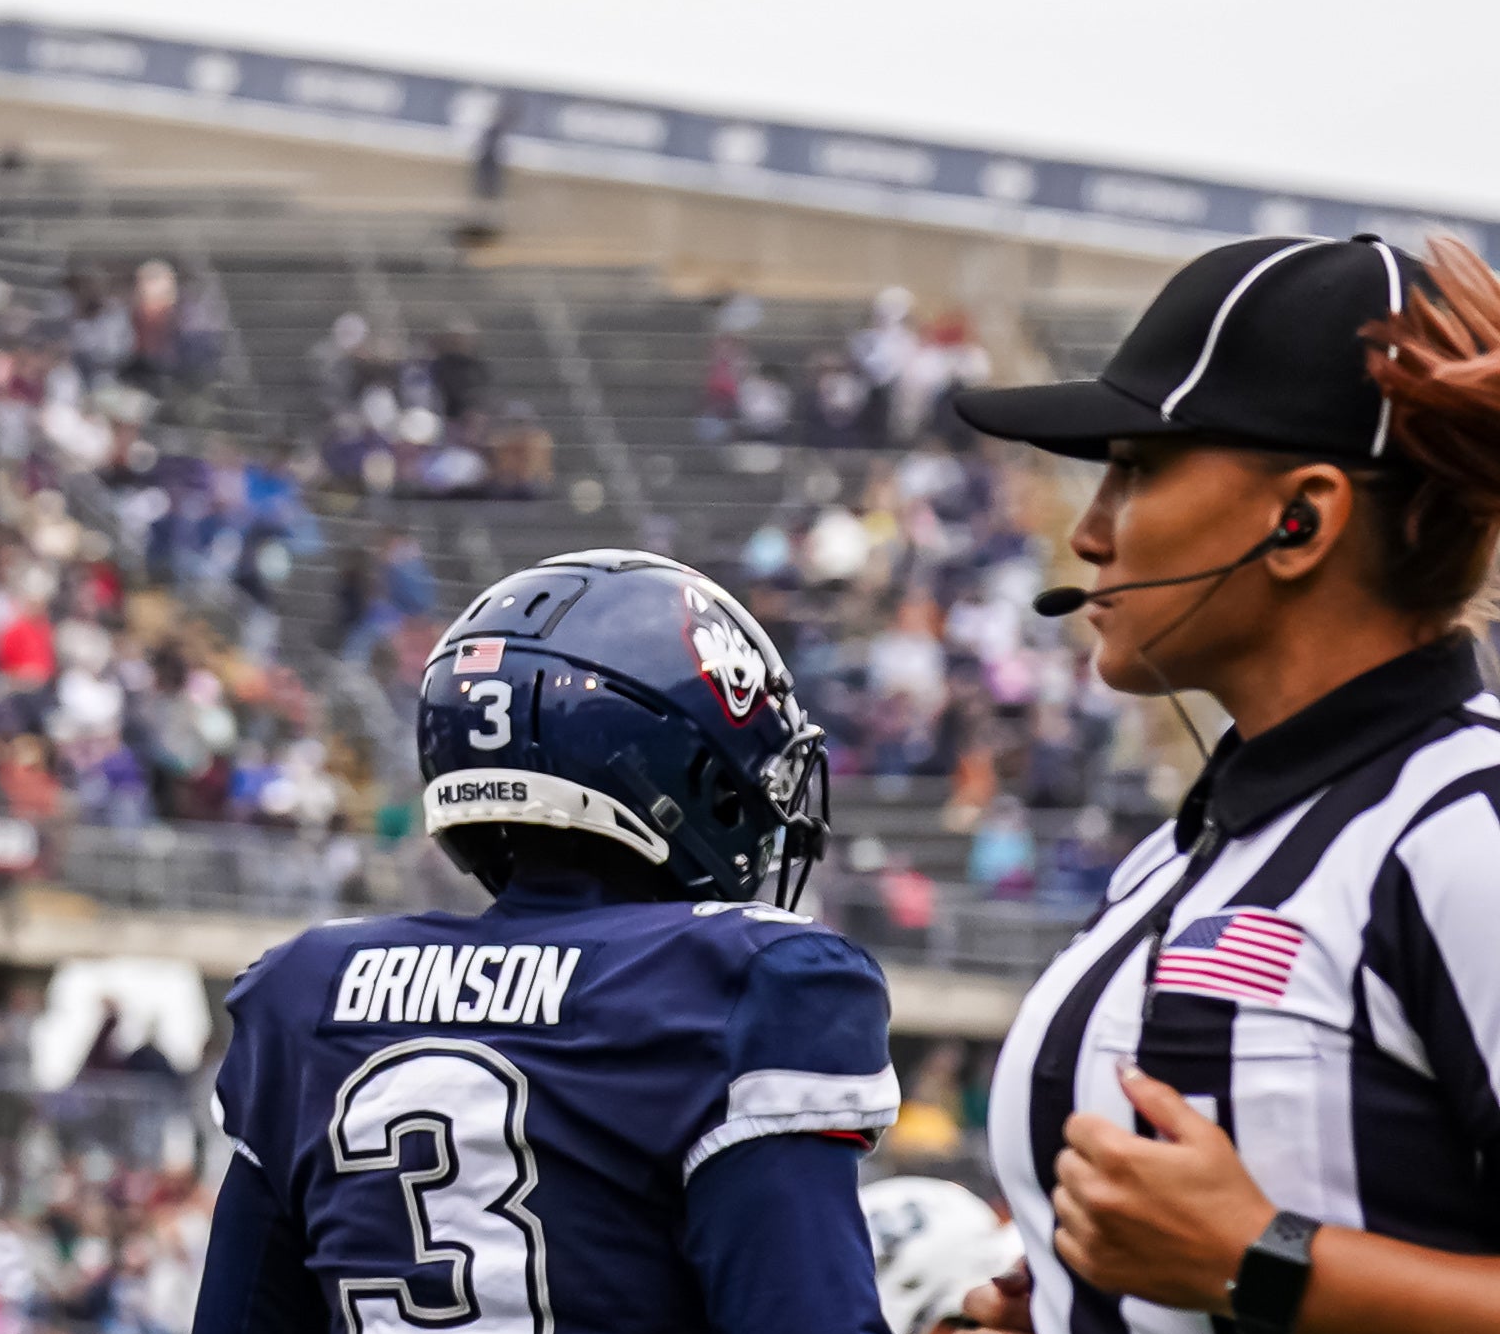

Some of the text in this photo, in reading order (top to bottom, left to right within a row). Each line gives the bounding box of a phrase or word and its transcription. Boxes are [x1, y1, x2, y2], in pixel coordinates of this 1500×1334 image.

[468, 678, 514, 751] 3
[437, 781, 529, 806] HUSKIES
[333, 944, 582, 1025] BRINSON
